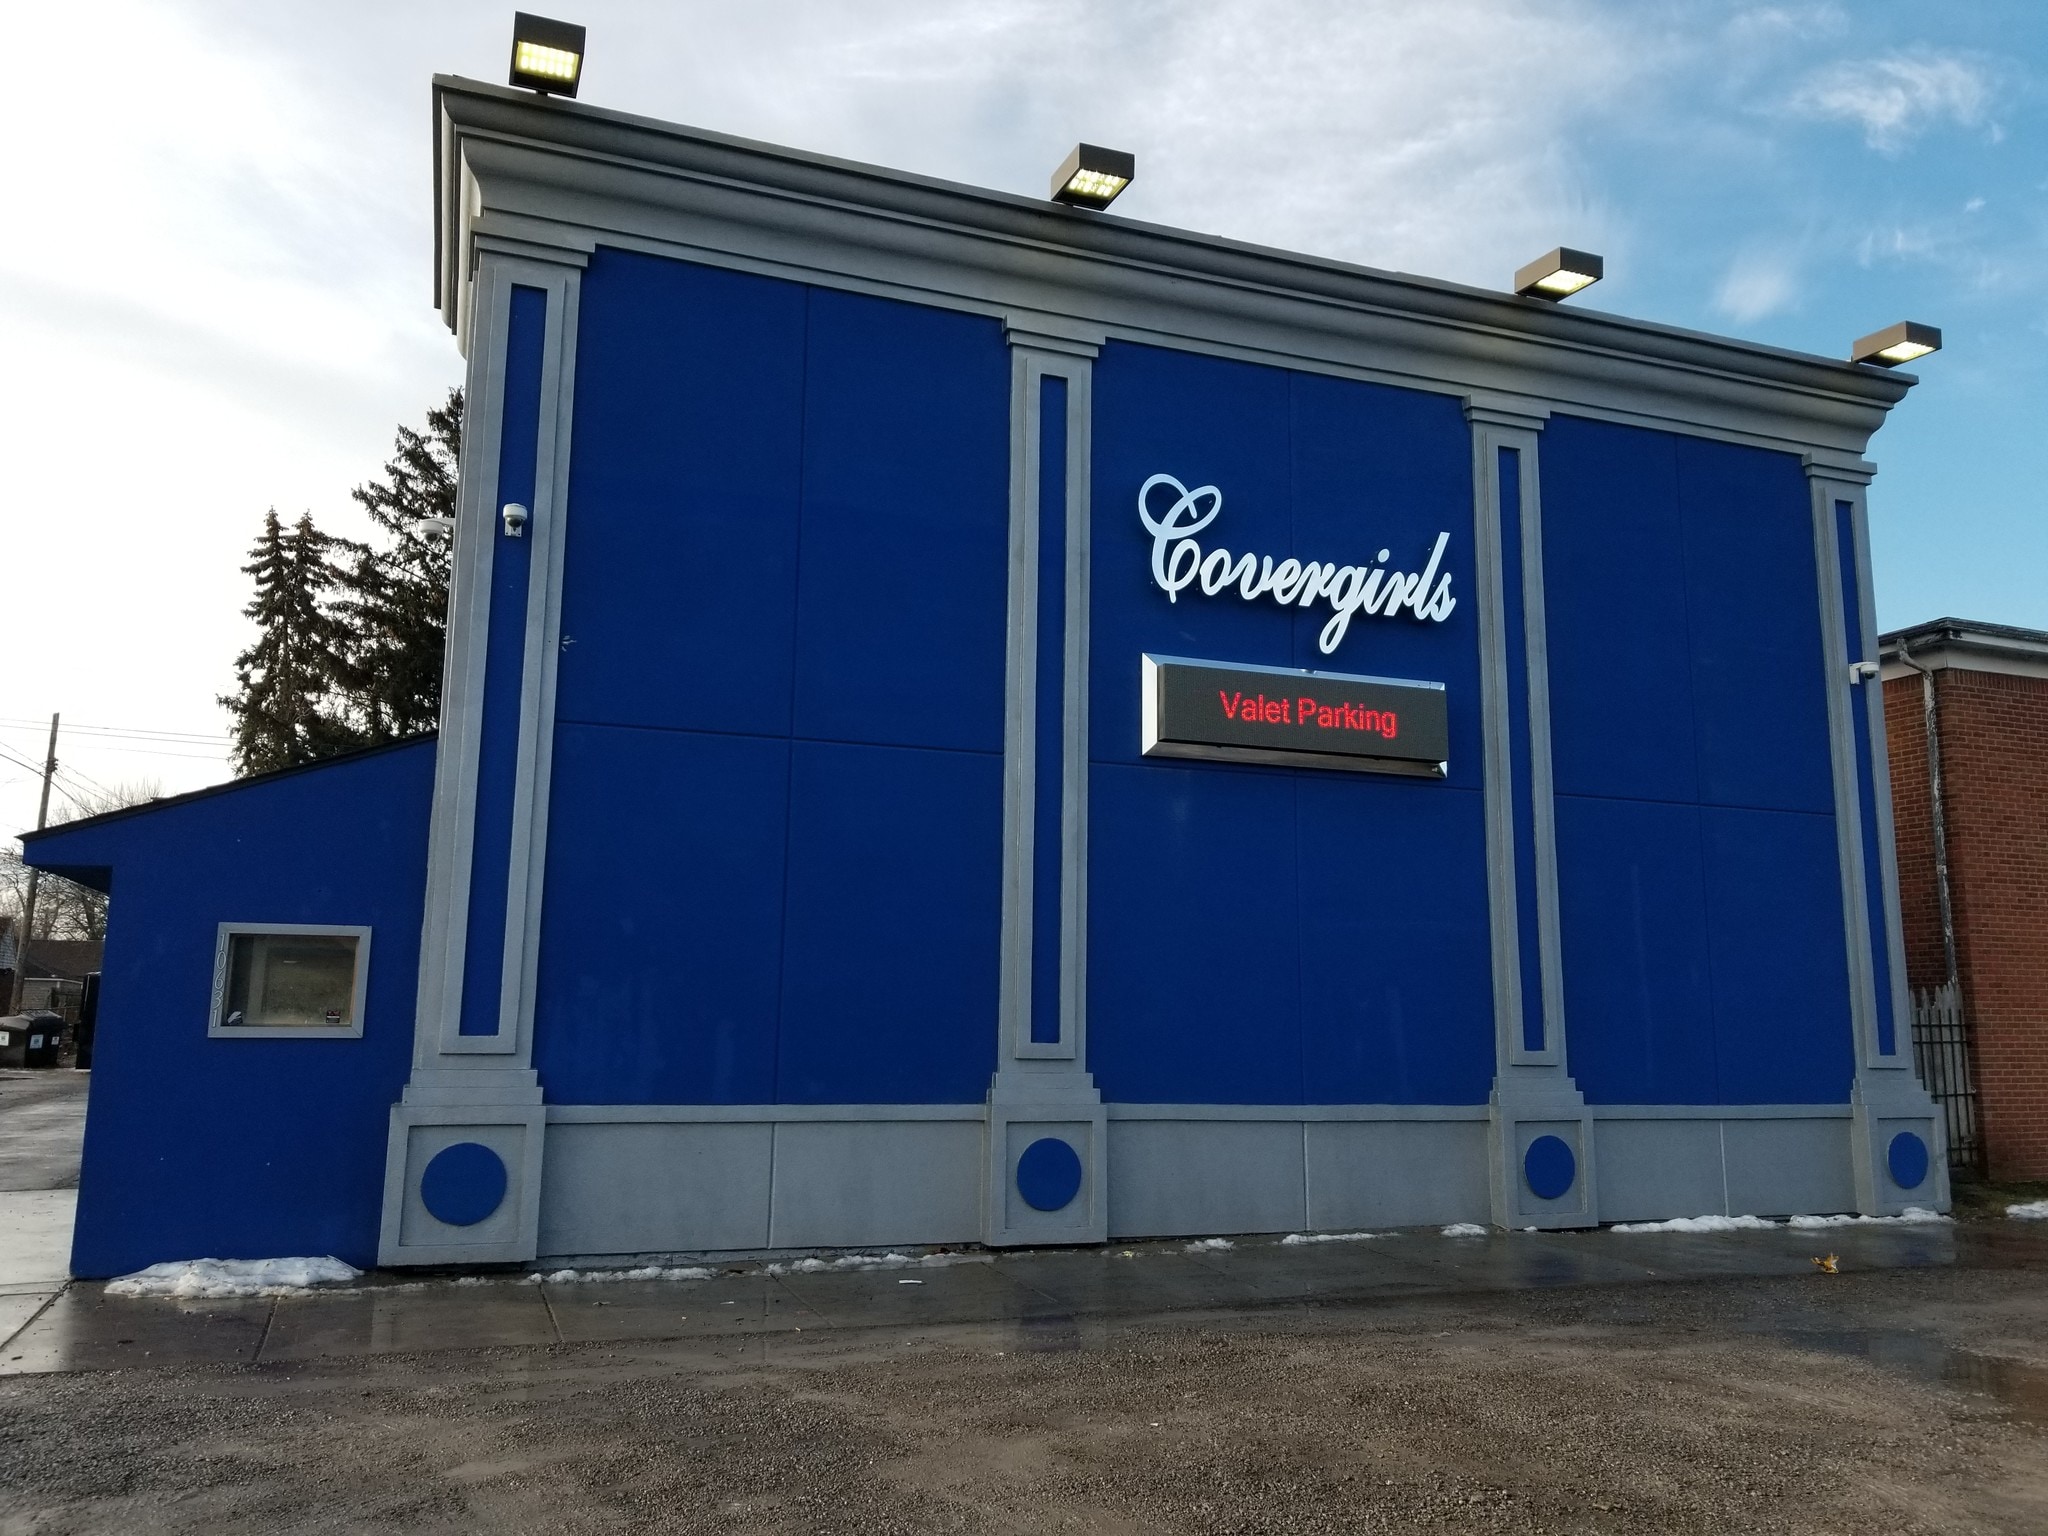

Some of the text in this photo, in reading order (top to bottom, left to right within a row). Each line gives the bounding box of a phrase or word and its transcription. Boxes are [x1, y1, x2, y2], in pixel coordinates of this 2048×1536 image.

[1138, 473, 1456, 654] Covergirls
[1219, 690, 1398, 739] Valet Parking
[212, 934, 227, 1028] 10631
